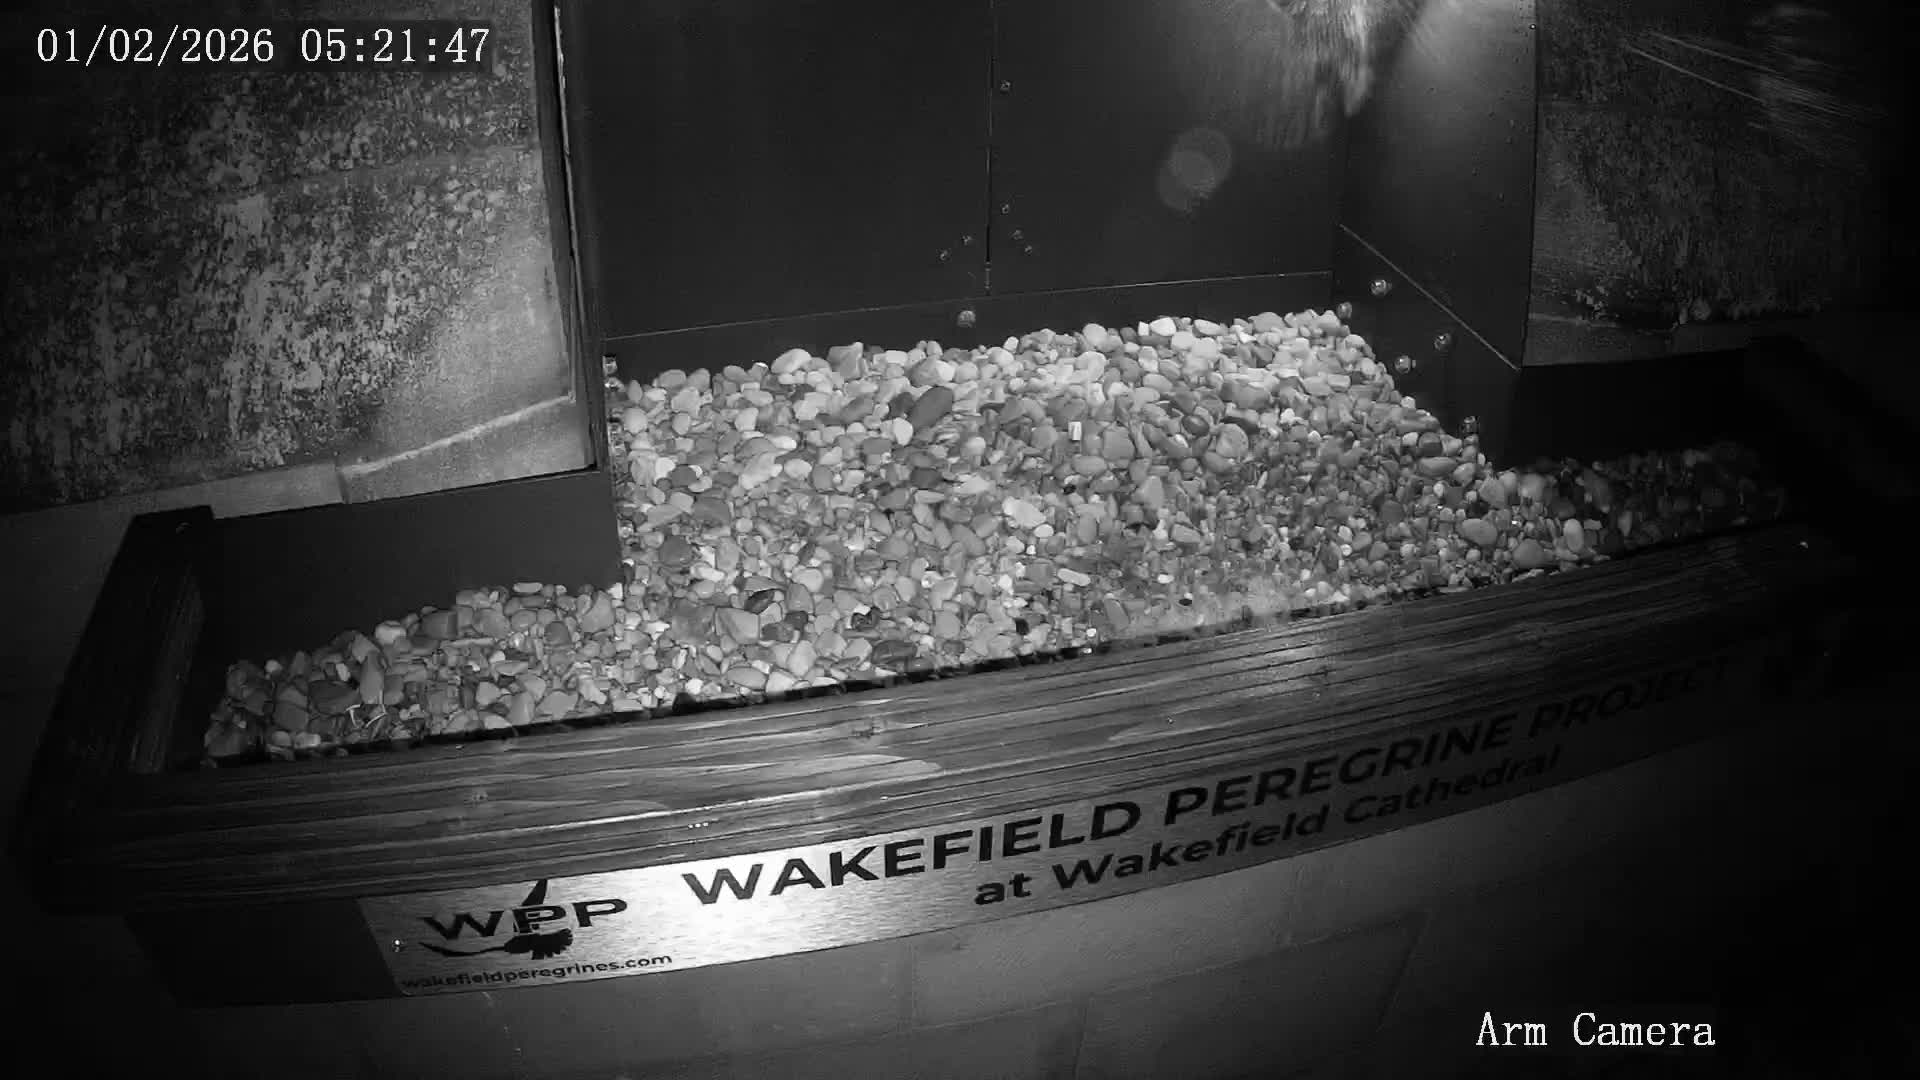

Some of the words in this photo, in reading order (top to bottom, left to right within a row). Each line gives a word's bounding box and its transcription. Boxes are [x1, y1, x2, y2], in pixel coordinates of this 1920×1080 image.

[682, 800, 1141, 905] WAKEFIELD
[1164, 713, 1517, 826] PEREGRINE
[975, 873, 1032, 905] at
[1052, 804, 1329, 889] Wakefield
[1343, 743, 1560, 823] Cathedral
[421, 898, 628, 939] WPP
[401, 953, 673, 988] wakefieldperegrines.com
